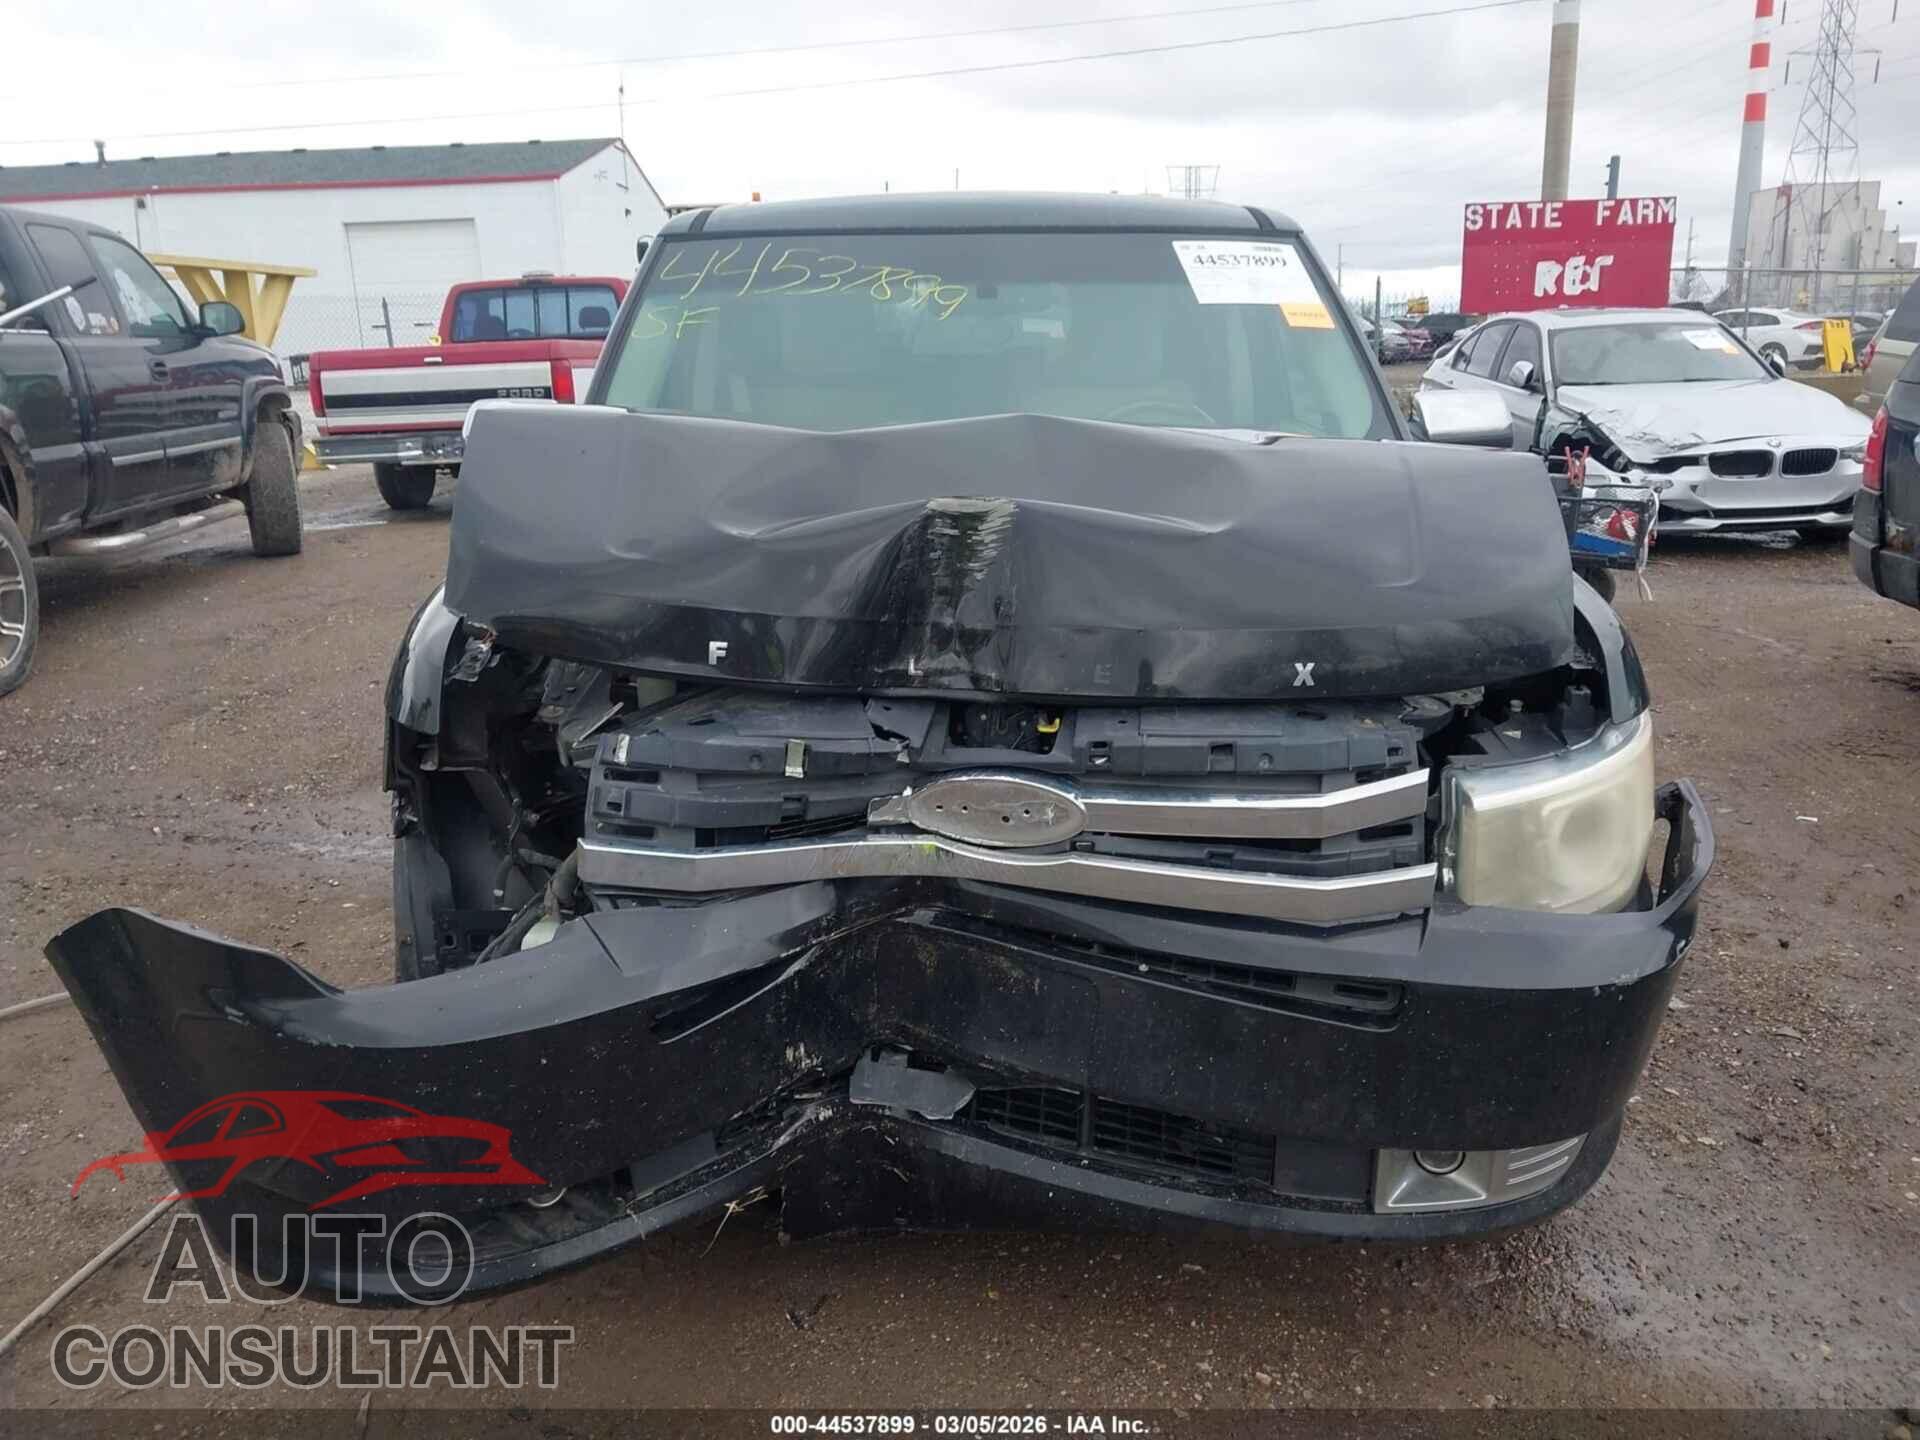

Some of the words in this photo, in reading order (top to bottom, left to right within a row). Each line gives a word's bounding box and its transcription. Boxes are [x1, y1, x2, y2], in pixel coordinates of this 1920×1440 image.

[1466, 202, 1563, 230] STATE
[1596, 197, 1675, 226] FARM
[1194, 254, 1287, 267] 44537899
